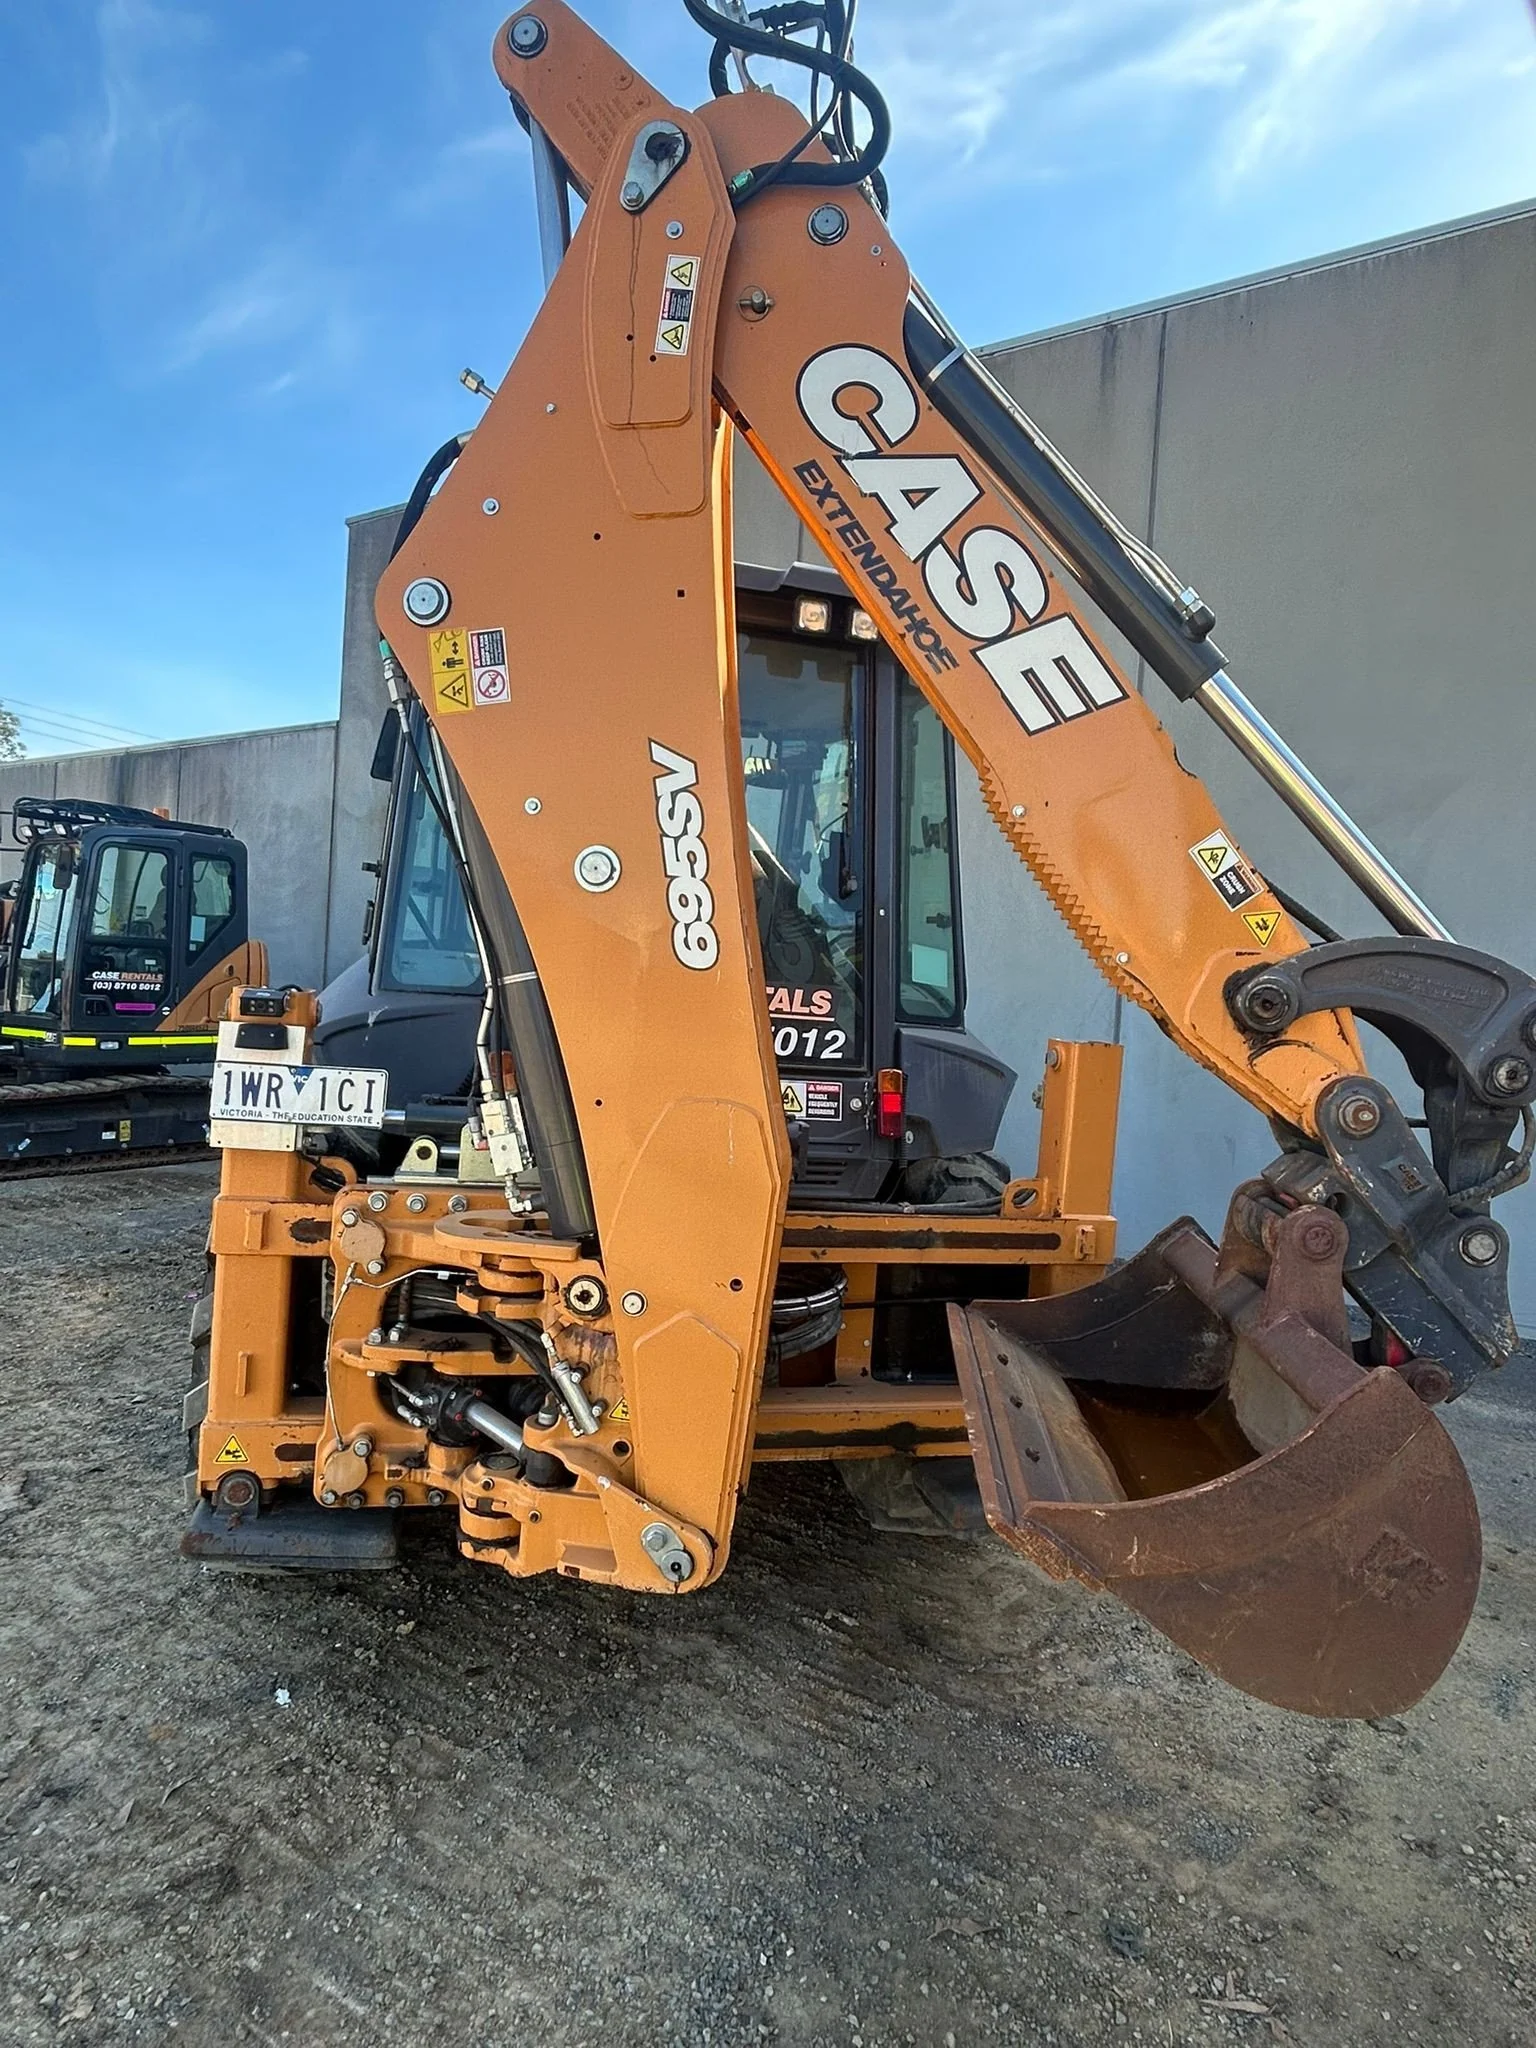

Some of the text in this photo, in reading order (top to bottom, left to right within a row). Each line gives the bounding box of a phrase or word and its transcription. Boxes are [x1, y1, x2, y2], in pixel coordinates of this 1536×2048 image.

[795, 342, 1131, 737] CASE
[793, 459, 960, 675] EXTENDAHOE
[648, 737, 721, 971] 695SV
[1219, 876, 1236, 896] ZONE
[1227, 871, 1246, 895] CRUSH
[92, 971, 163, 981] CASE RENTALS
[93, 981, 112, 990] (03)
[114, 982, 137, 990] 8710
[772, 1026, 846, 1059] 012
[223, 1070, 283, 1108] 1WR
[320, 1077, 376, 1113] 1CI
[220, 1109, 263, 1119] VICTORIA
[272, 1111, 290, 1120] THE
[290, 1113, 344, 1122] EDUCATION
[347, 1115, 373, 1124] STATE
